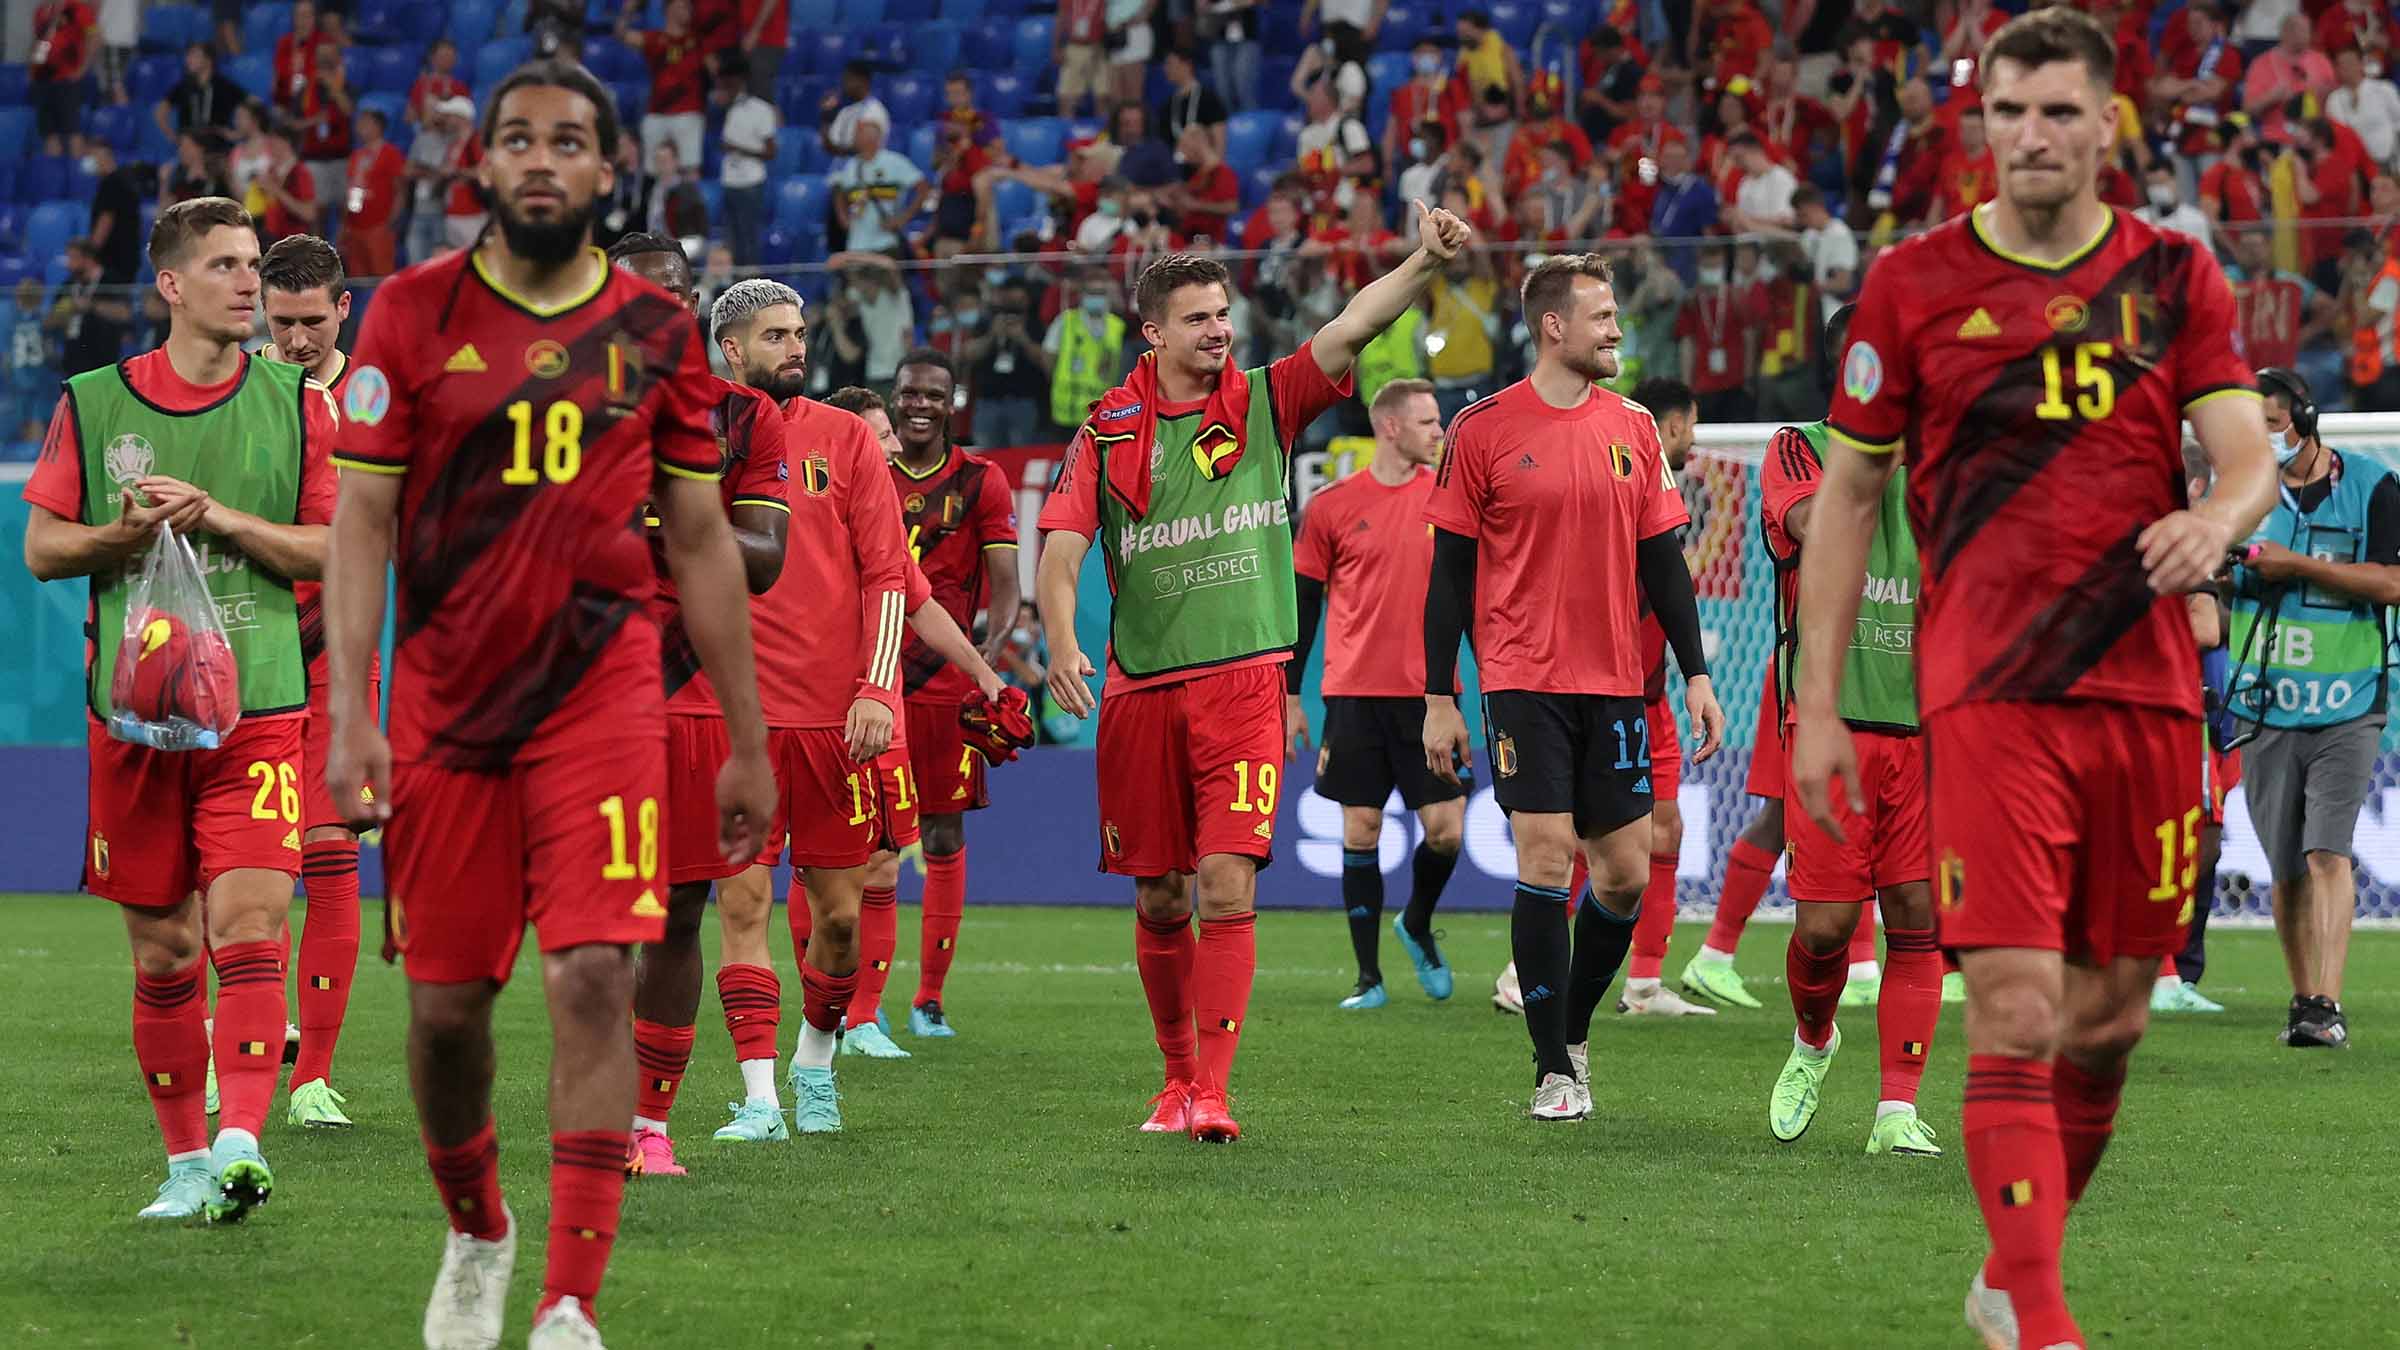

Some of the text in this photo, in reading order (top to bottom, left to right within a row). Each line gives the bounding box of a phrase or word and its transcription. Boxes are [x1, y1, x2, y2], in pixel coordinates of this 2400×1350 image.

[1111, 405, 1141, 418] RESPECT
[2035, 342, 2115, 420] 15
[501, 400, 584, 484] 18
[1183, 554, 1259, 587] RESPECT
[1613, 718, 1650, 770] 12
[248, 760, 300, 825] 26
[1230, 760, 1277, 816] 19
[598, 795, 660, 881] 18
[2147, 805, 2201, 902] 15
